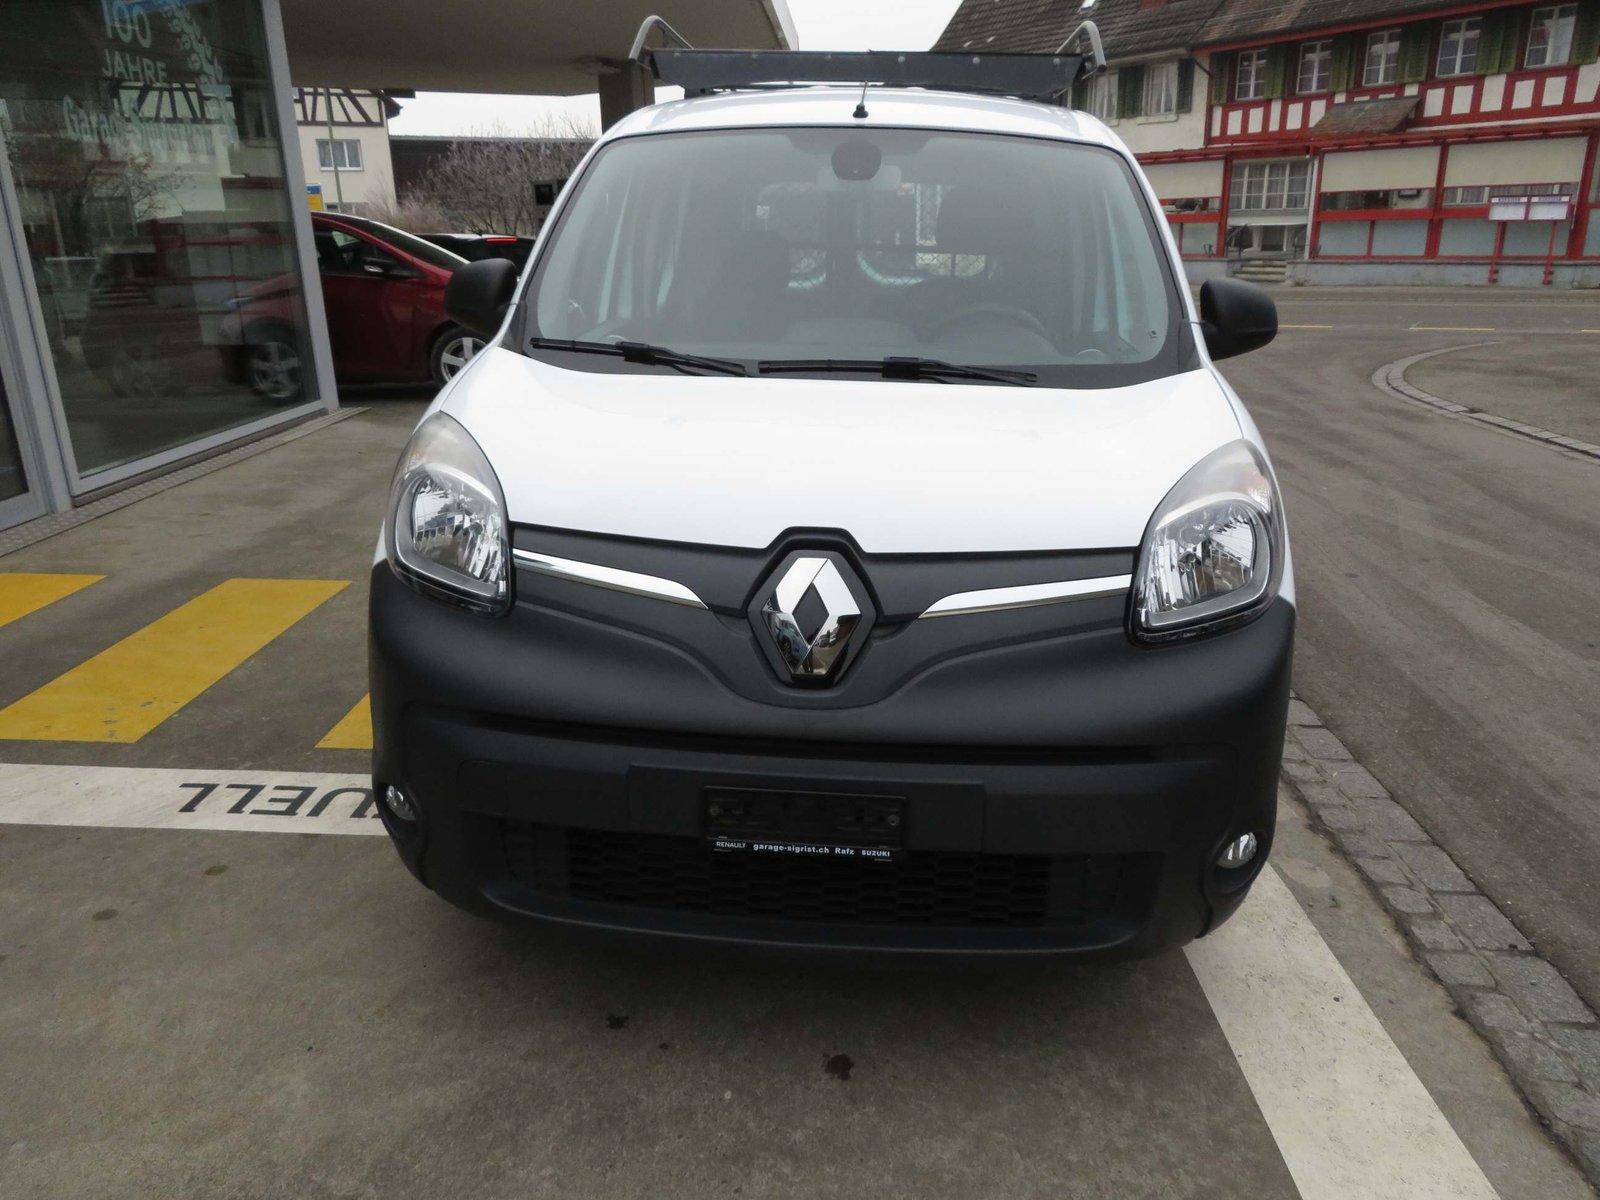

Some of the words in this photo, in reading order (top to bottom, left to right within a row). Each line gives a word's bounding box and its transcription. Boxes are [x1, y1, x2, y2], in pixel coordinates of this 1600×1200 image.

[101, 0, 152, 48] 100
[102, 48, 168, 86] JAHRE
[177, 782, 381, 819] UELL
[716, 841, 746, 849] RENAULT
[753, 842, 830, 854] garage-sigrist.ch
[834, 847, 855, 855] Rafz
[861, 849, 890, 857] SUZUKI
